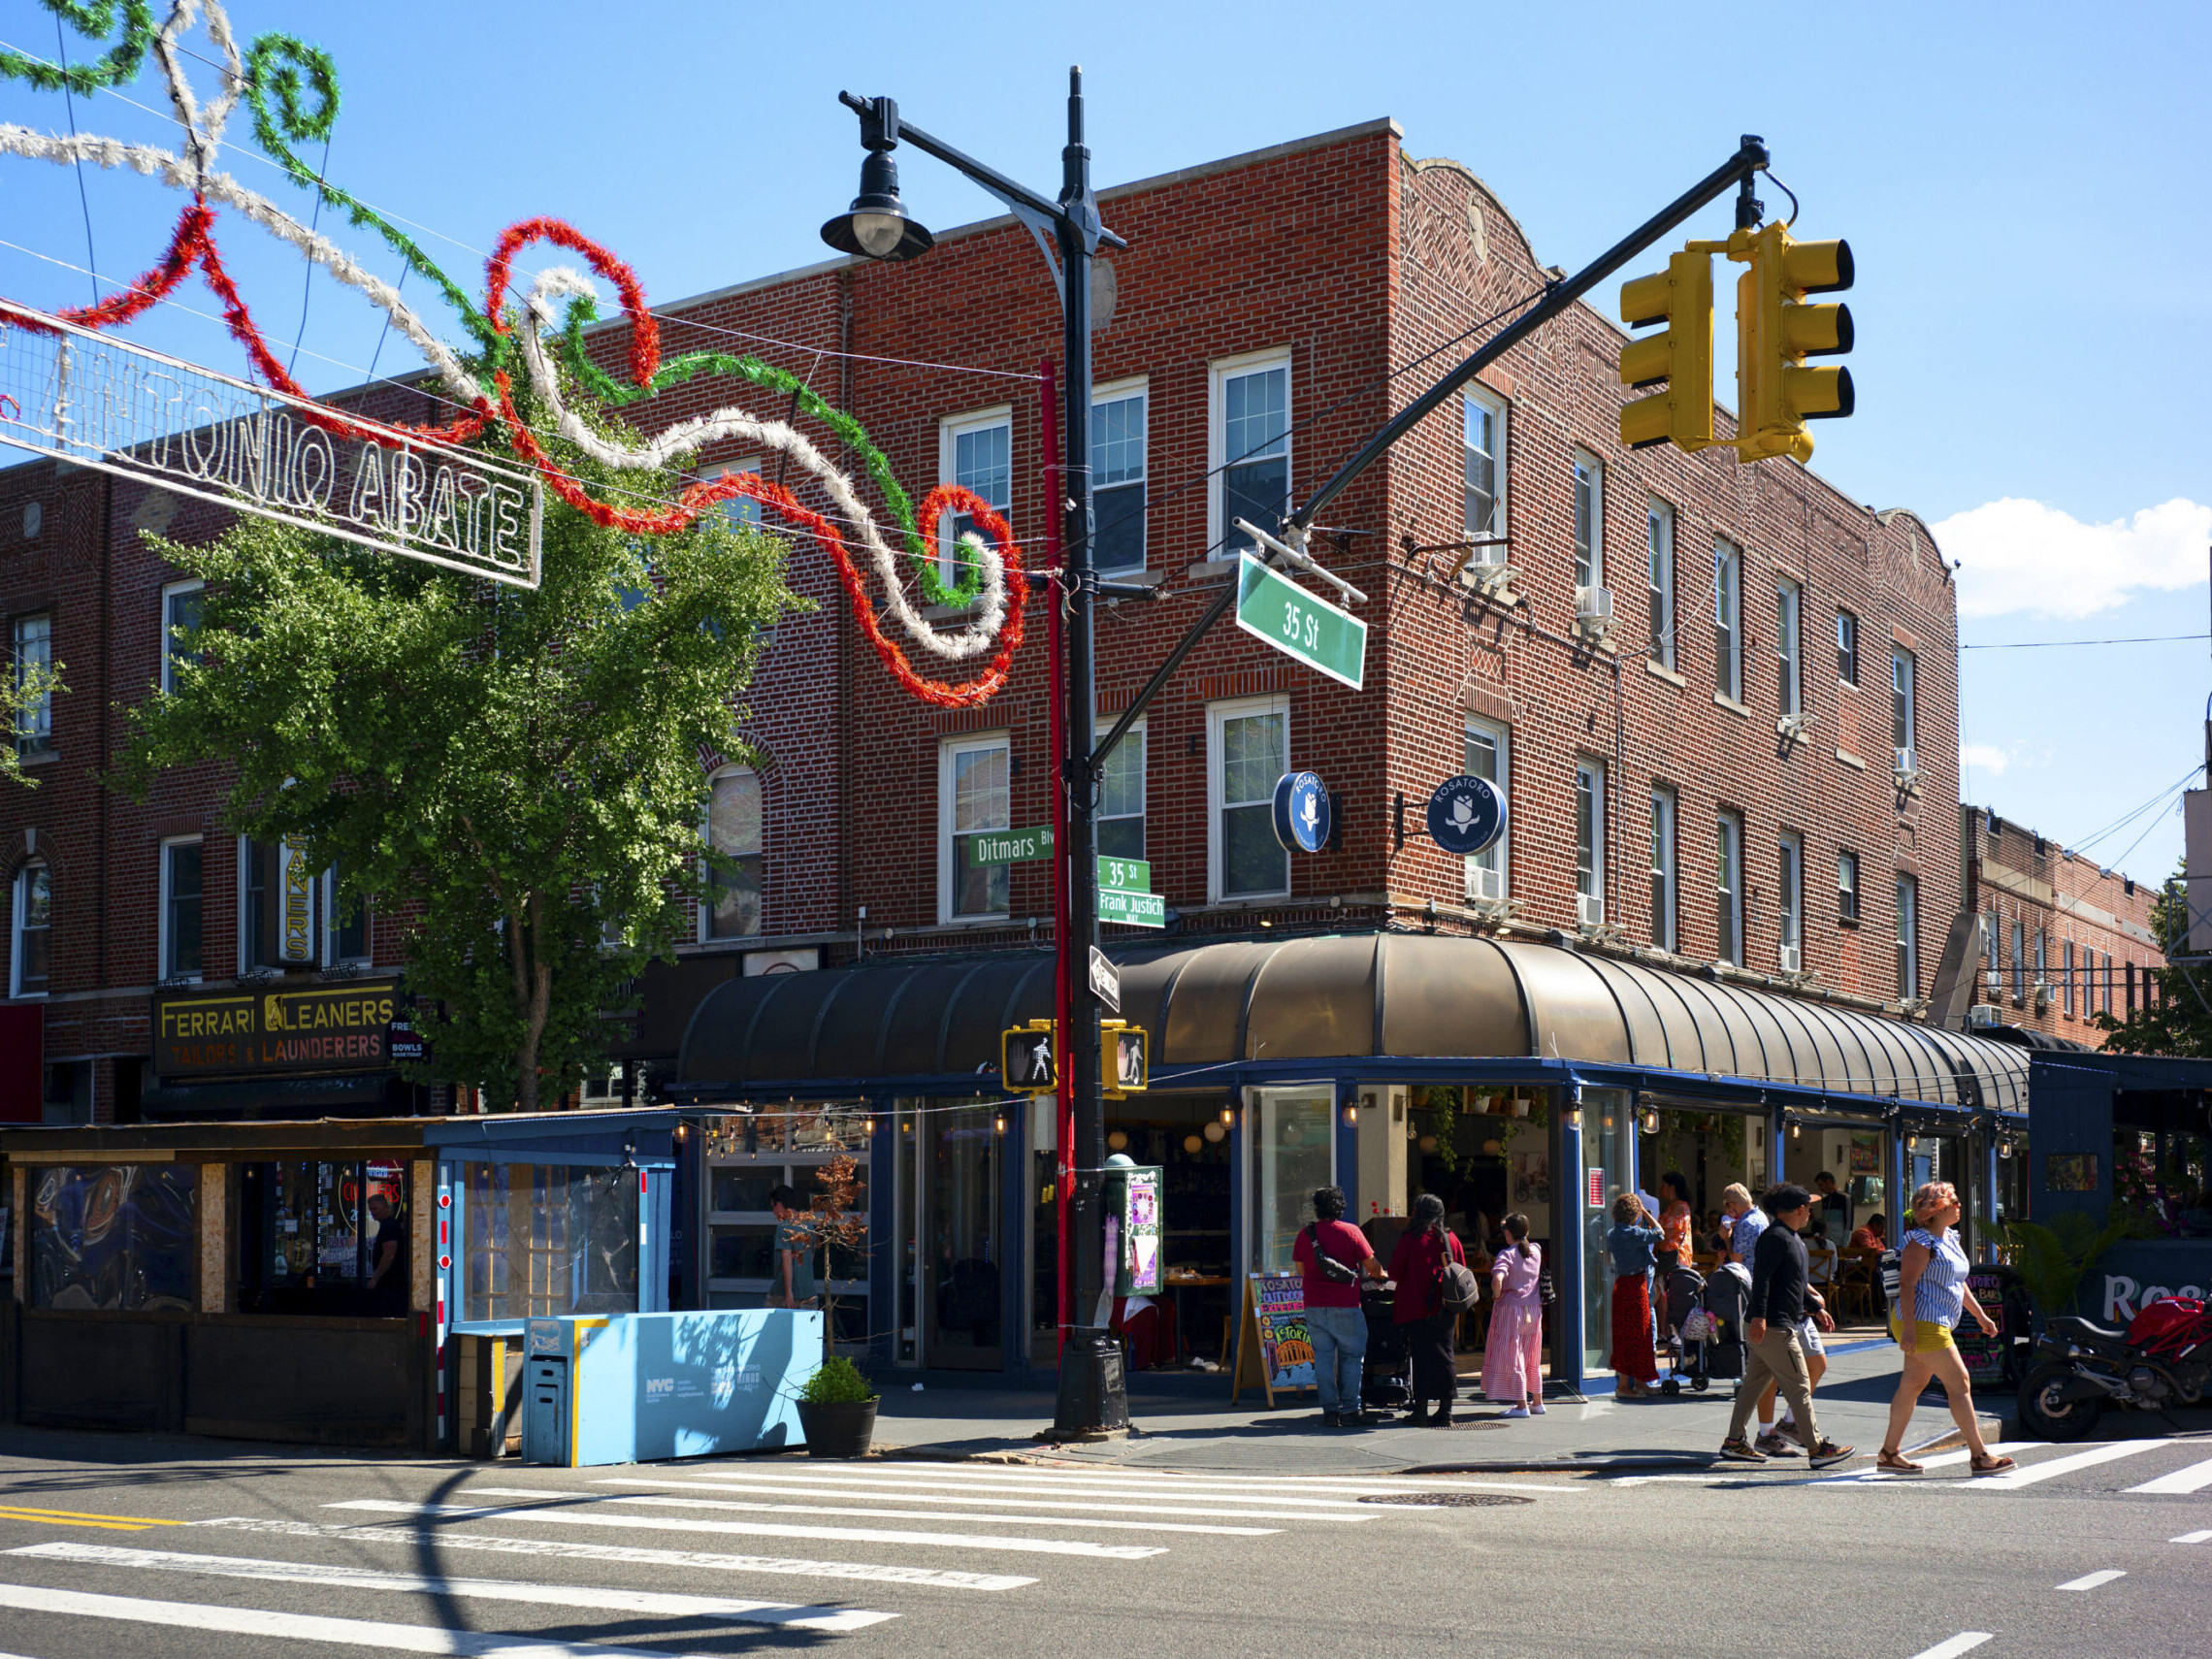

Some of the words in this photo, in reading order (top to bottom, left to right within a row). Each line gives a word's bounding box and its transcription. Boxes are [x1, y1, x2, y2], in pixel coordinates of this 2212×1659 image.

[37, 339, 336, 511] ANTONIO
[349, 440, 528, 570] ABATE
[1283, 602, 1301, 640] 35
[1304, 613, 1319, 651] St
[1295, 775, 1326, 803] ROSATORO
[1434, 778, 1491, 803] ROSATORO
[978, 836, 1035, 862] Ditmars
[1041, 830, 1055, 846] Blv
[1109, 862, 1124, 887] 35
[1128, 864, 1137, 880] St
[285, 829, 309, 960] EANERS
[1099, 893, 1127, 912] Frank
[1129, 897, 1163, 917] Justich
[1125, 913, 1139, 923] WAY
[161, 996, 254, 1038] FERRARI
[391, 1022, 409, 1031] FRE
[172, 1042, 237, 1066] TAILORS
[261, 1034, 381, 1063] LAUNDERERS
[392, 1043, 422, 1052] BOWLS
[1275, 1325, 1313, 1348] ASTORIA
[646, 1378, 673, 1393] NYC
